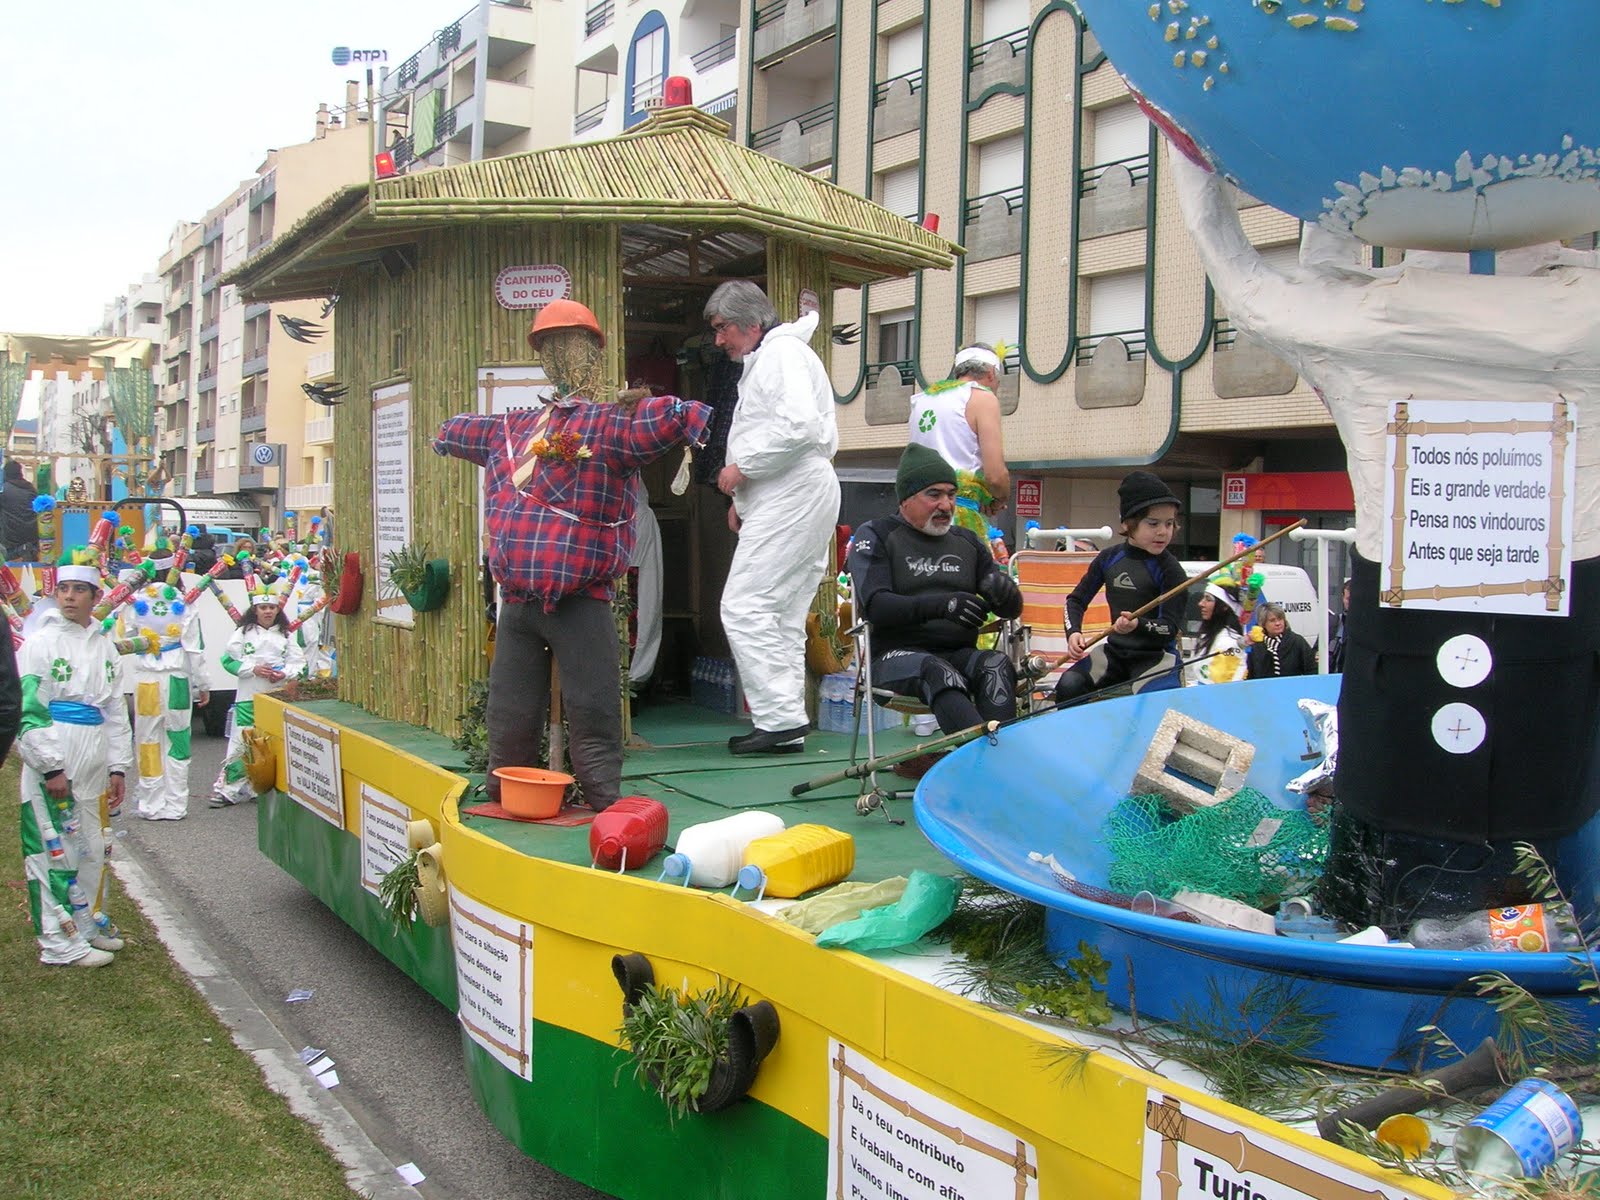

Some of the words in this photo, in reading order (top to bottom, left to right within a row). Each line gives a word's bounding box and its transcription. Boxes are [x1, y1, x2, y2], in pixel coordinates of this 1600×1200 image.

[504, 274, 562, 286] CANTINHO
[513, 290, 528, 299] DO
[531, 287, 554, 298] CÉU
[1412, 446, 1451, 465] Todos
[1454, 447, 1479, 466] nós
[1482, 448, 1542, 470] poluímos
[1411, 478, 1430, 497] Eis
[1434, 483, 1442, 497] a
[1445, 479, 1490, 502] grande
[1494, 480, 1546, 500] verdade
[1410, 509, 1449, 529] Pensa
[1452, 514, 1477, 530] nos
[1480, 512, 1546, 532] vindouros
[1408, 541, 1445, 560] Antes
[1449, 546, 1473, 565] que
[1476, 544, 1503, 567] seja
[1506, 545, 1540, 564] tarde
[942, 562, 961, 572] line
[1284, 602, 1312, 613] JUNKERS
[484, 939, 509, 964] situação
[493, 968, 503, 983] dar
[852, 1094, 865, 1116] Dá
[867, 1110, 873, 1121] o
[875, 1115, 893, 1135] teu
[896, 1129, 965, 1173] contributo
[851, 1125, 858, 1141] E
[859, 1131, 904, 1173] trabalha
[907, 1163, 936, 1192] com
[850, 1154, 882, 1191] Vamos
